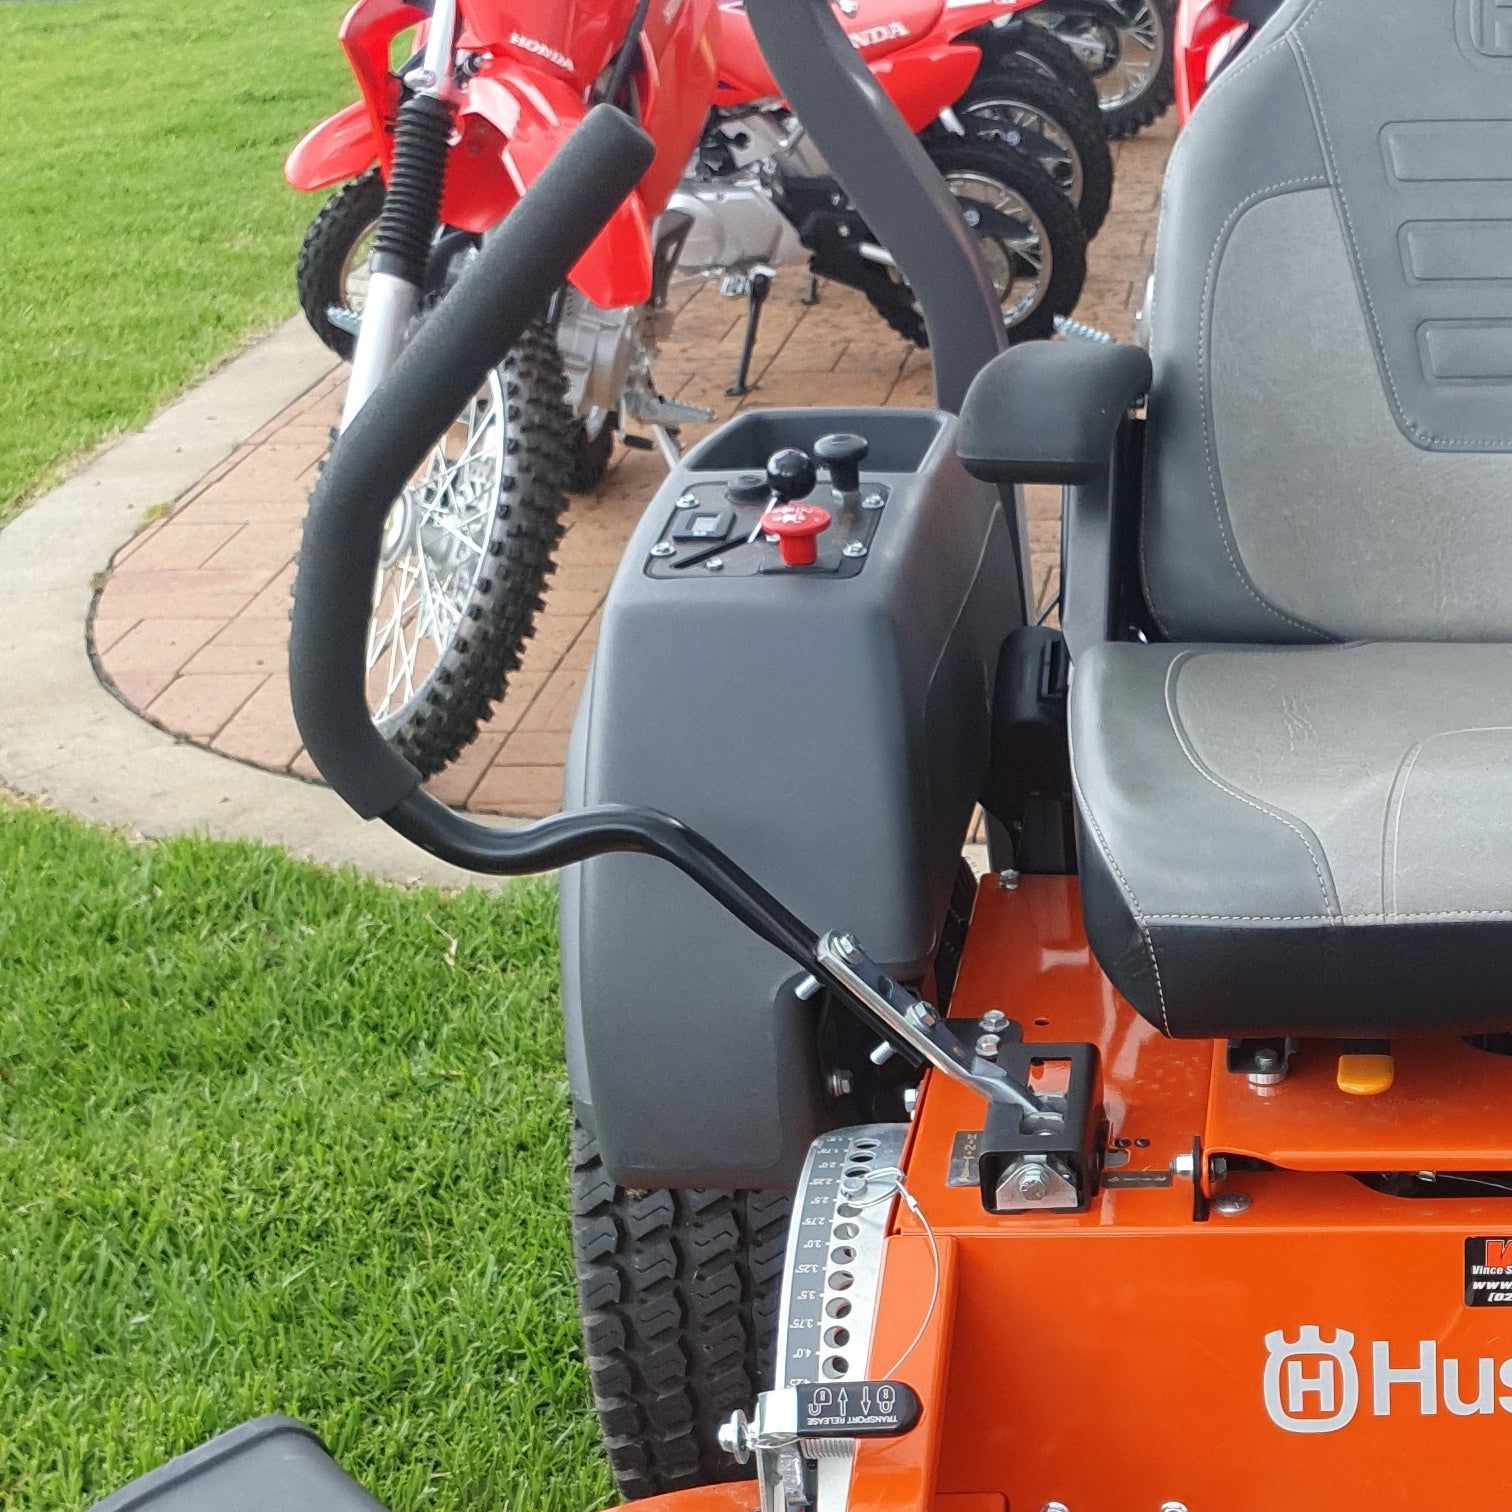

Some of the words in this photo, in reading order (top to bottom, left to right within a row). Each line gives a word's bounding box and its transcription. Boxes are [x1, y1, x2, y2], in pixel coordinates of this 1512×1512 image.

[508, 31, 574, 72] HONDA
[1472, 1265, 1503, 1275] Vince
[806, 1416, 846, 1426] RELEASE
[847, 1415, 898, 1425] TRANSPORT
